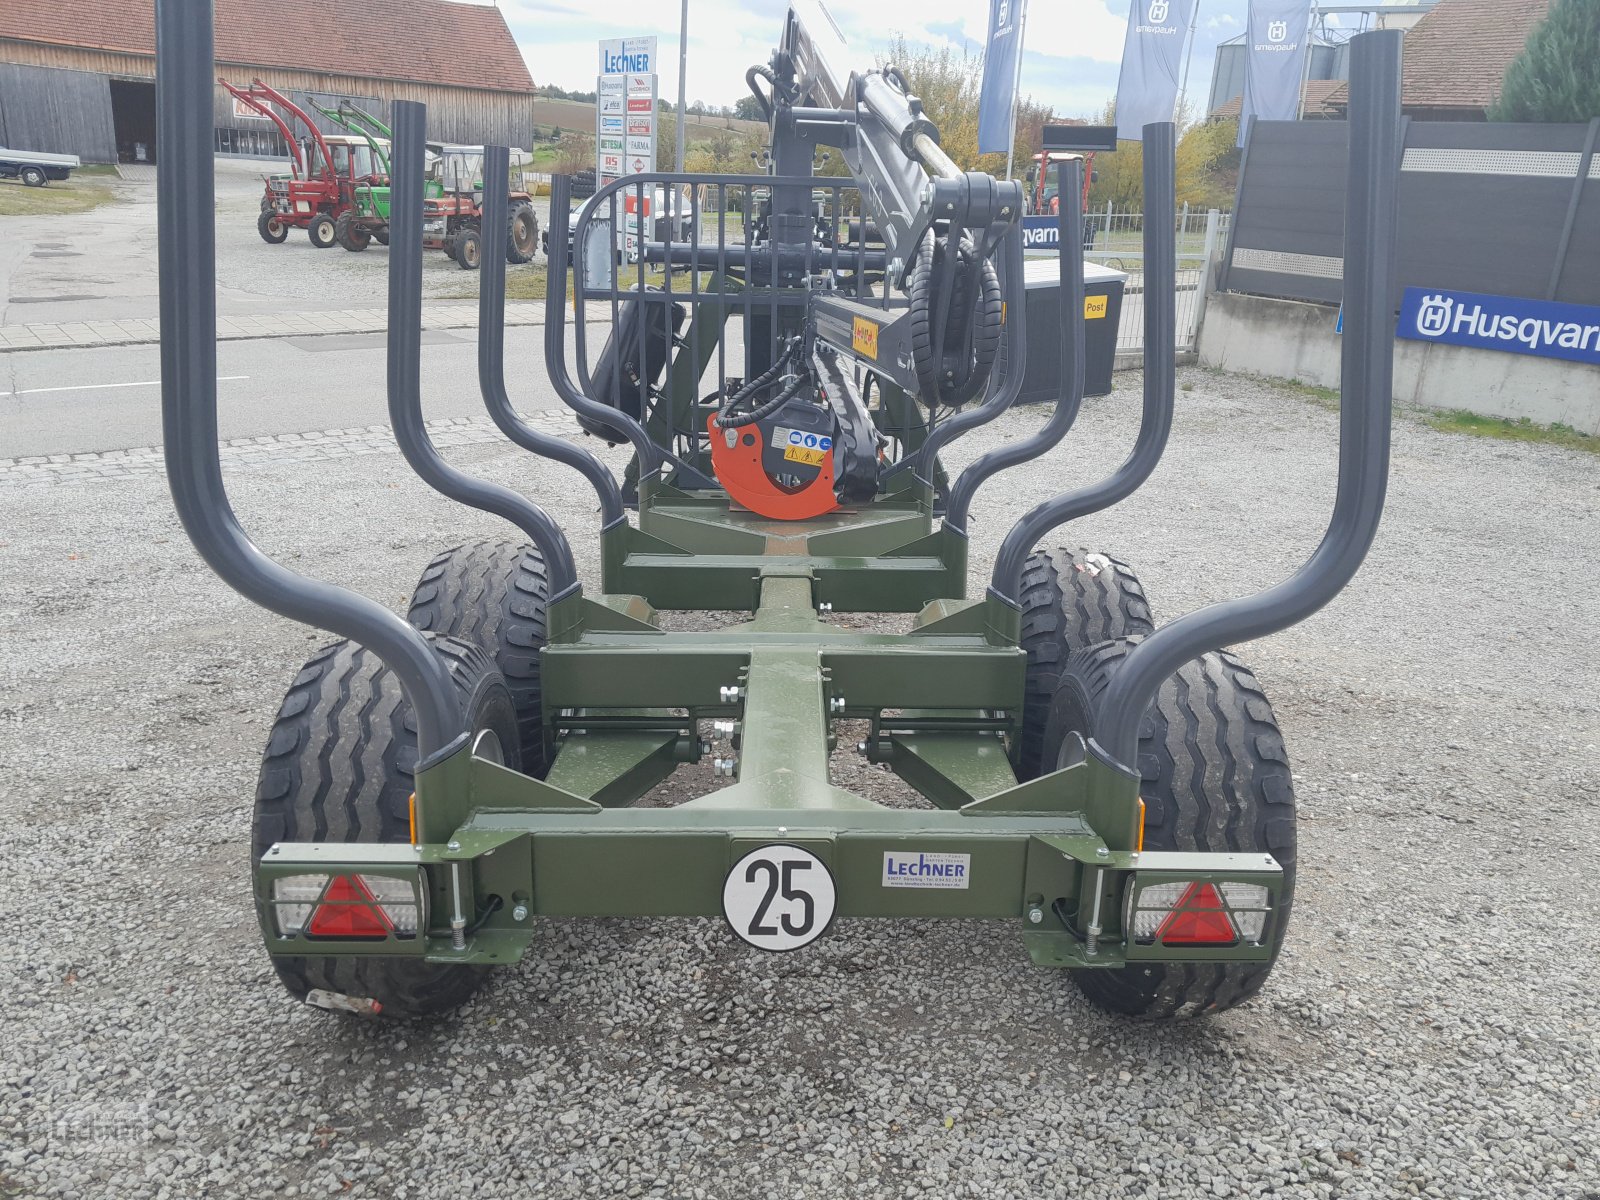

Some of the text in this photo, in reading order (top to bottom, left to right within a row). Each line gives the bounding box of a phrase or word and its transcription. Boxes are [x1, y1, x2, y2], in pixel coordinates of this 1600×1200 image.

[1087, 303, 1104, 312] Post
[1452, 303, 1600, 351] Husqvar
[745, 859, 815, 936] 25
